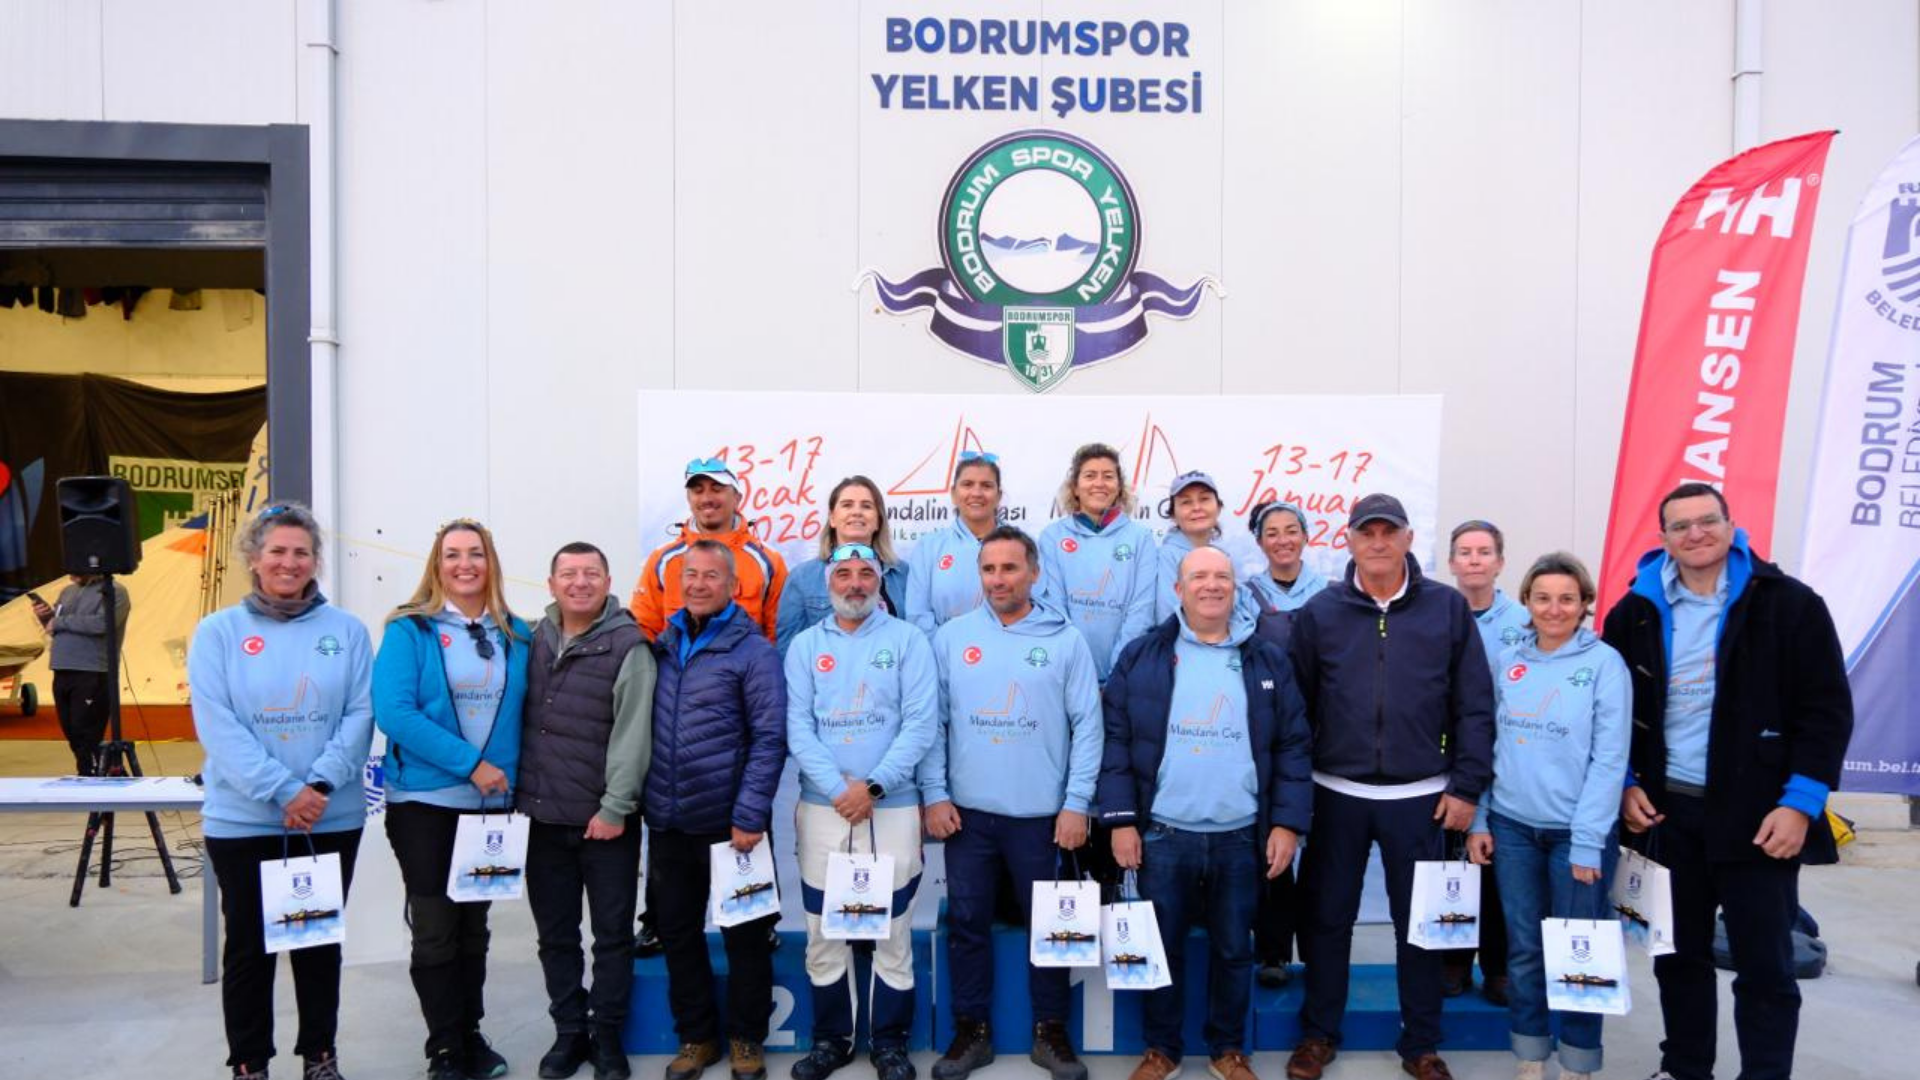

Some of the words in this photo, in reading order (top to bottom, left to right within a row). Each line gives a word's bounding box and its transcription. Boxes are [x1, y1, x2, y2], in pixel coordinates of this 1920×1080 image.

[886, 17, 1190, 57] BODRUMSPOR
[871, 73, 1038, 111] YELKEN
[1050, 71, 1202, 118] ŞUBESİ
[956, 163, 1000, 296] BODRUM
[1010, 146, 1094, 180] SPOR
[1076, 184, 1124, 301] YELKEN
[1007, 311, 1071, 322] BODRUMSPOR
[1865, 289, 1920, 332] BELED
[1680, 269, 1761, 493] ANSEN
[1263, 444, 1373, 484] 13-17
[1850, 362, 1906, 527] BODRUM
[887, 498, 948, 522] ndalin
[1233, 470, 1362, 517] Janua
[752, 510, 822, 544] 026
[1308, 519, 1351, 550] 26
[453, 689, 493, 701] andarin
